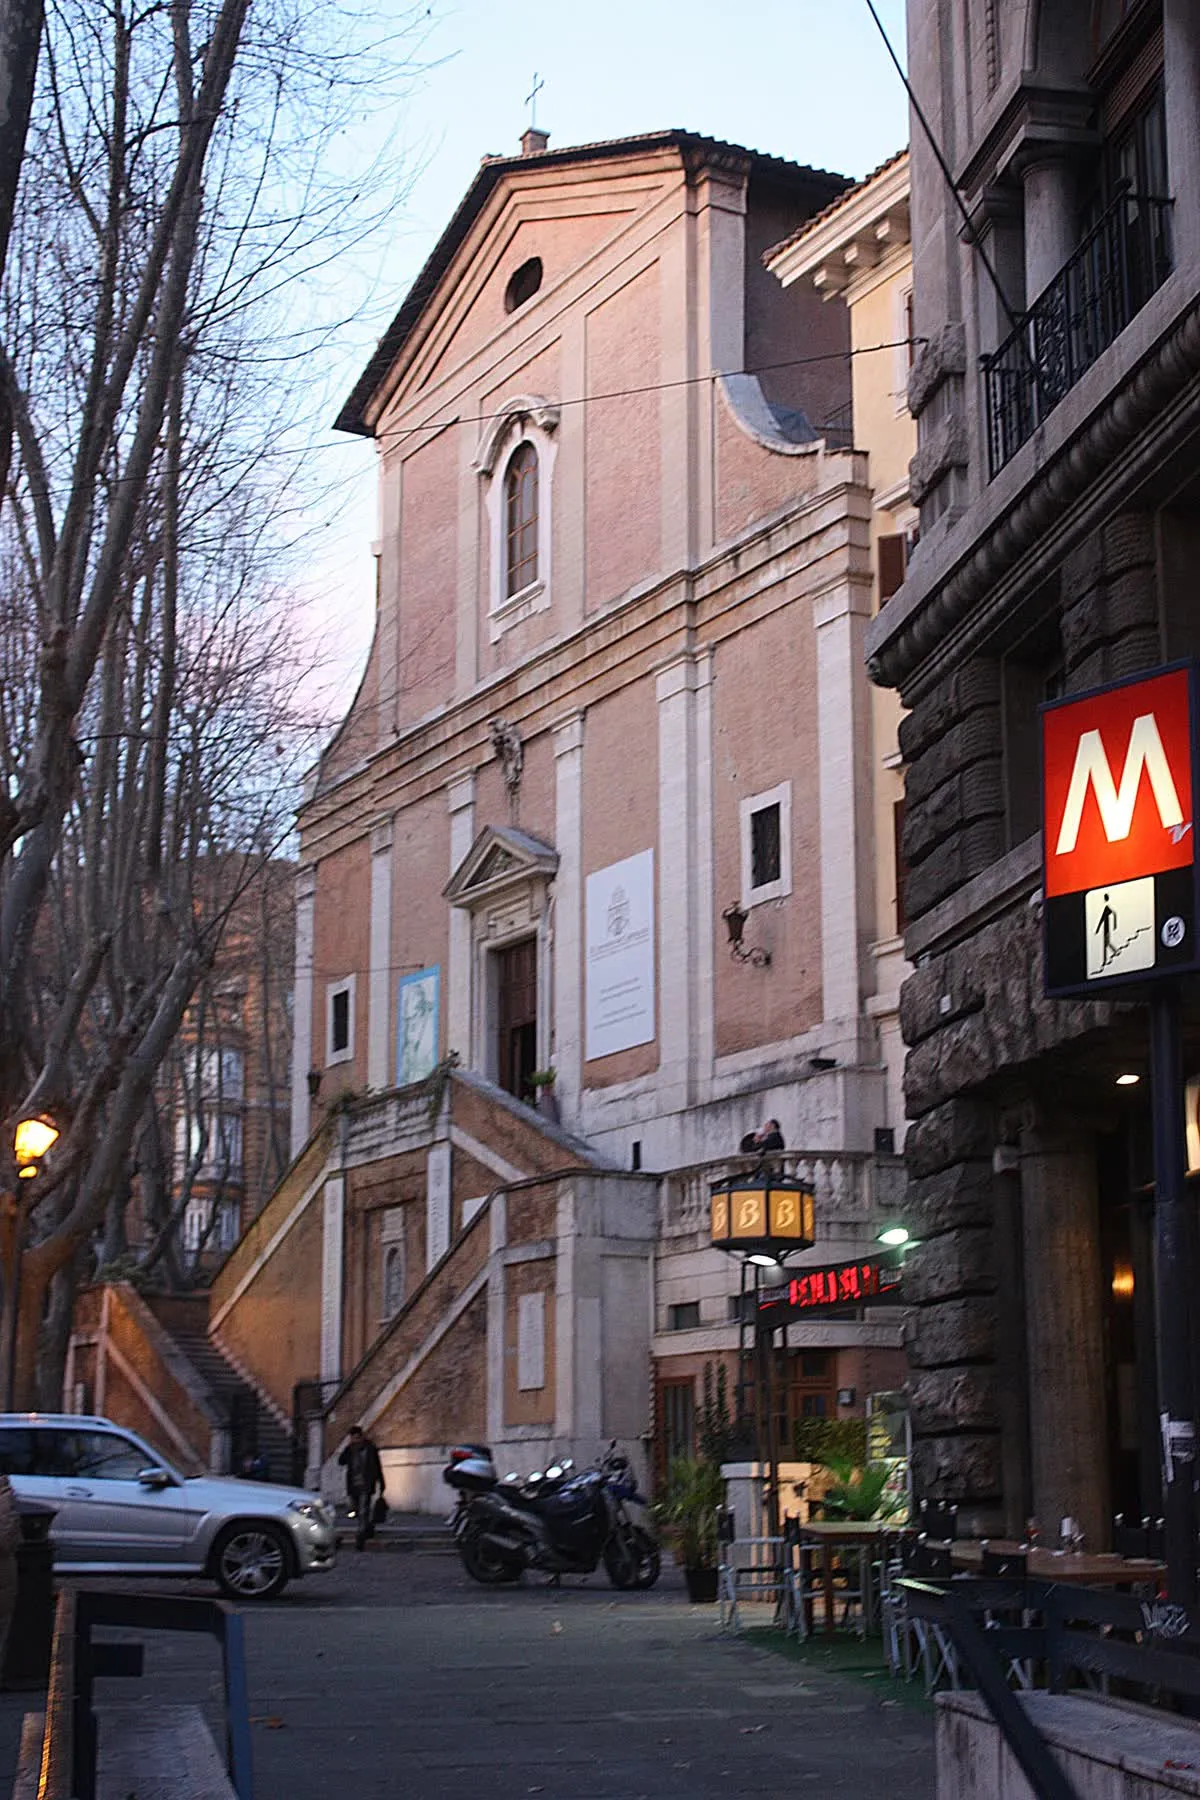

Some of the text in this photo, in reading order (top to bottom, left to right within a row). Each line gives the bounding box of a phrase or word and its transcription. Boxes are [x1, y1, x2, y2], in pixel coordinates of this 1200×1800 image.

[1055, 712, 1184, 855] M
[739, 1199, 760, 1229] B
[776, 1199, 795, 1229] B
